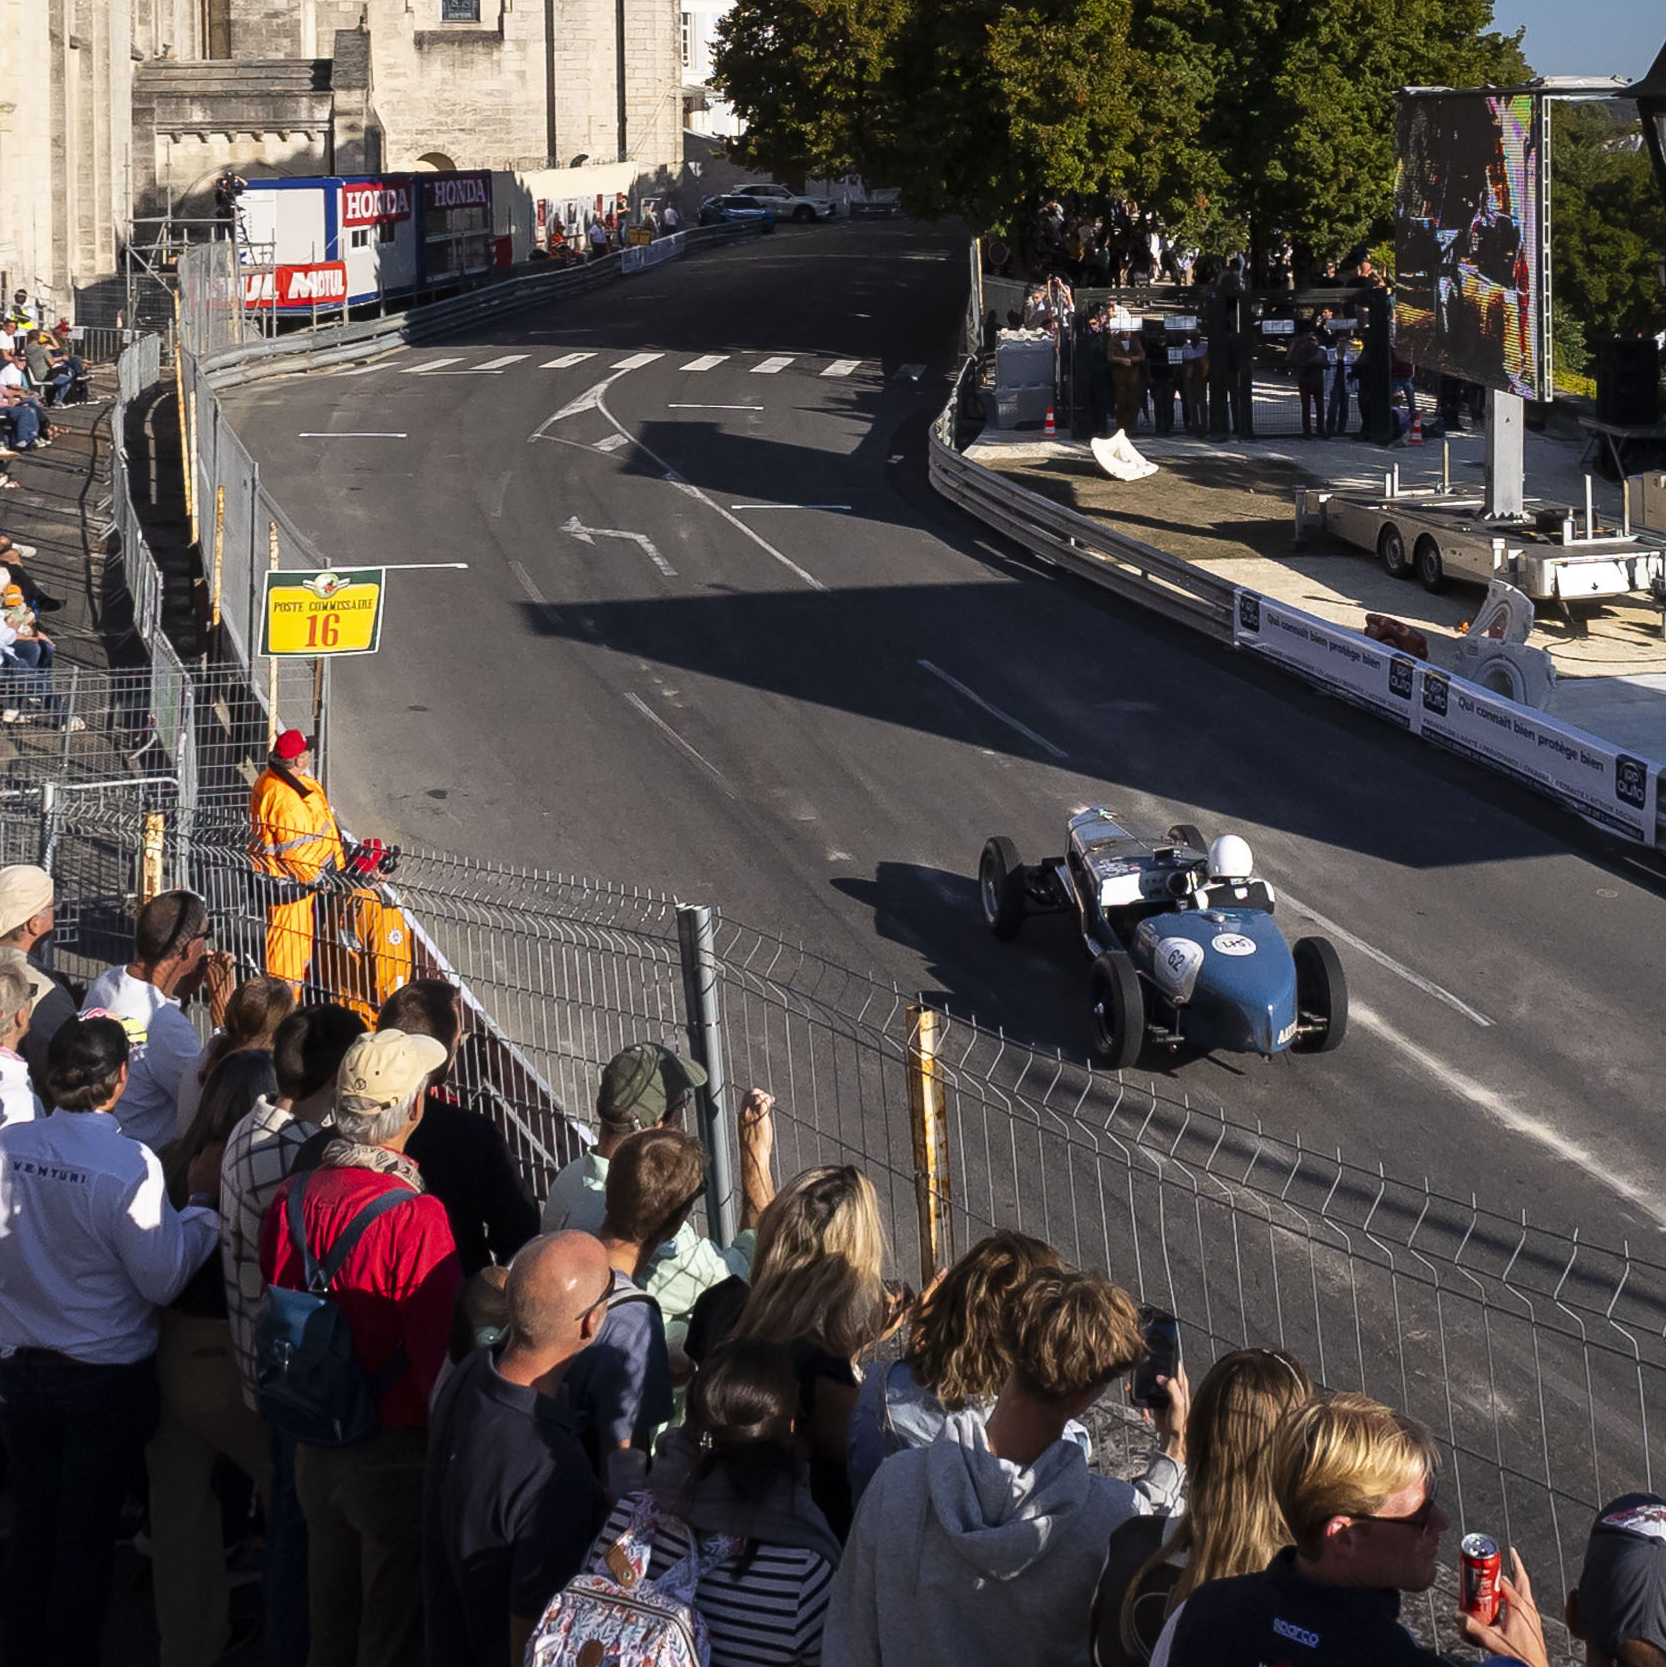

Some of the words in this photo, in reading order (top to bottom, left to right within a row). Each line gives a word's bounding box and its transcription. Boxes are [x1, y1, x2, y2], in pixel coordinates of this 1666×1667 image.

[346, 189, 410, 220] HONDA
[434, 179, 487, 207] HONDA
[288, 269, 345, 300] MOTUL
[274, 601, 304, 613] POSTE
[305, 613, 341, 647] 16
[1458, 696, 1474, 713] Qui
[1513, 720, 1536, 741] bien
[1580, 750, 1604, 773] bien
[1618, 780, 1644, 801] auto
[13, 1160, 86, 1184] VENTURI
